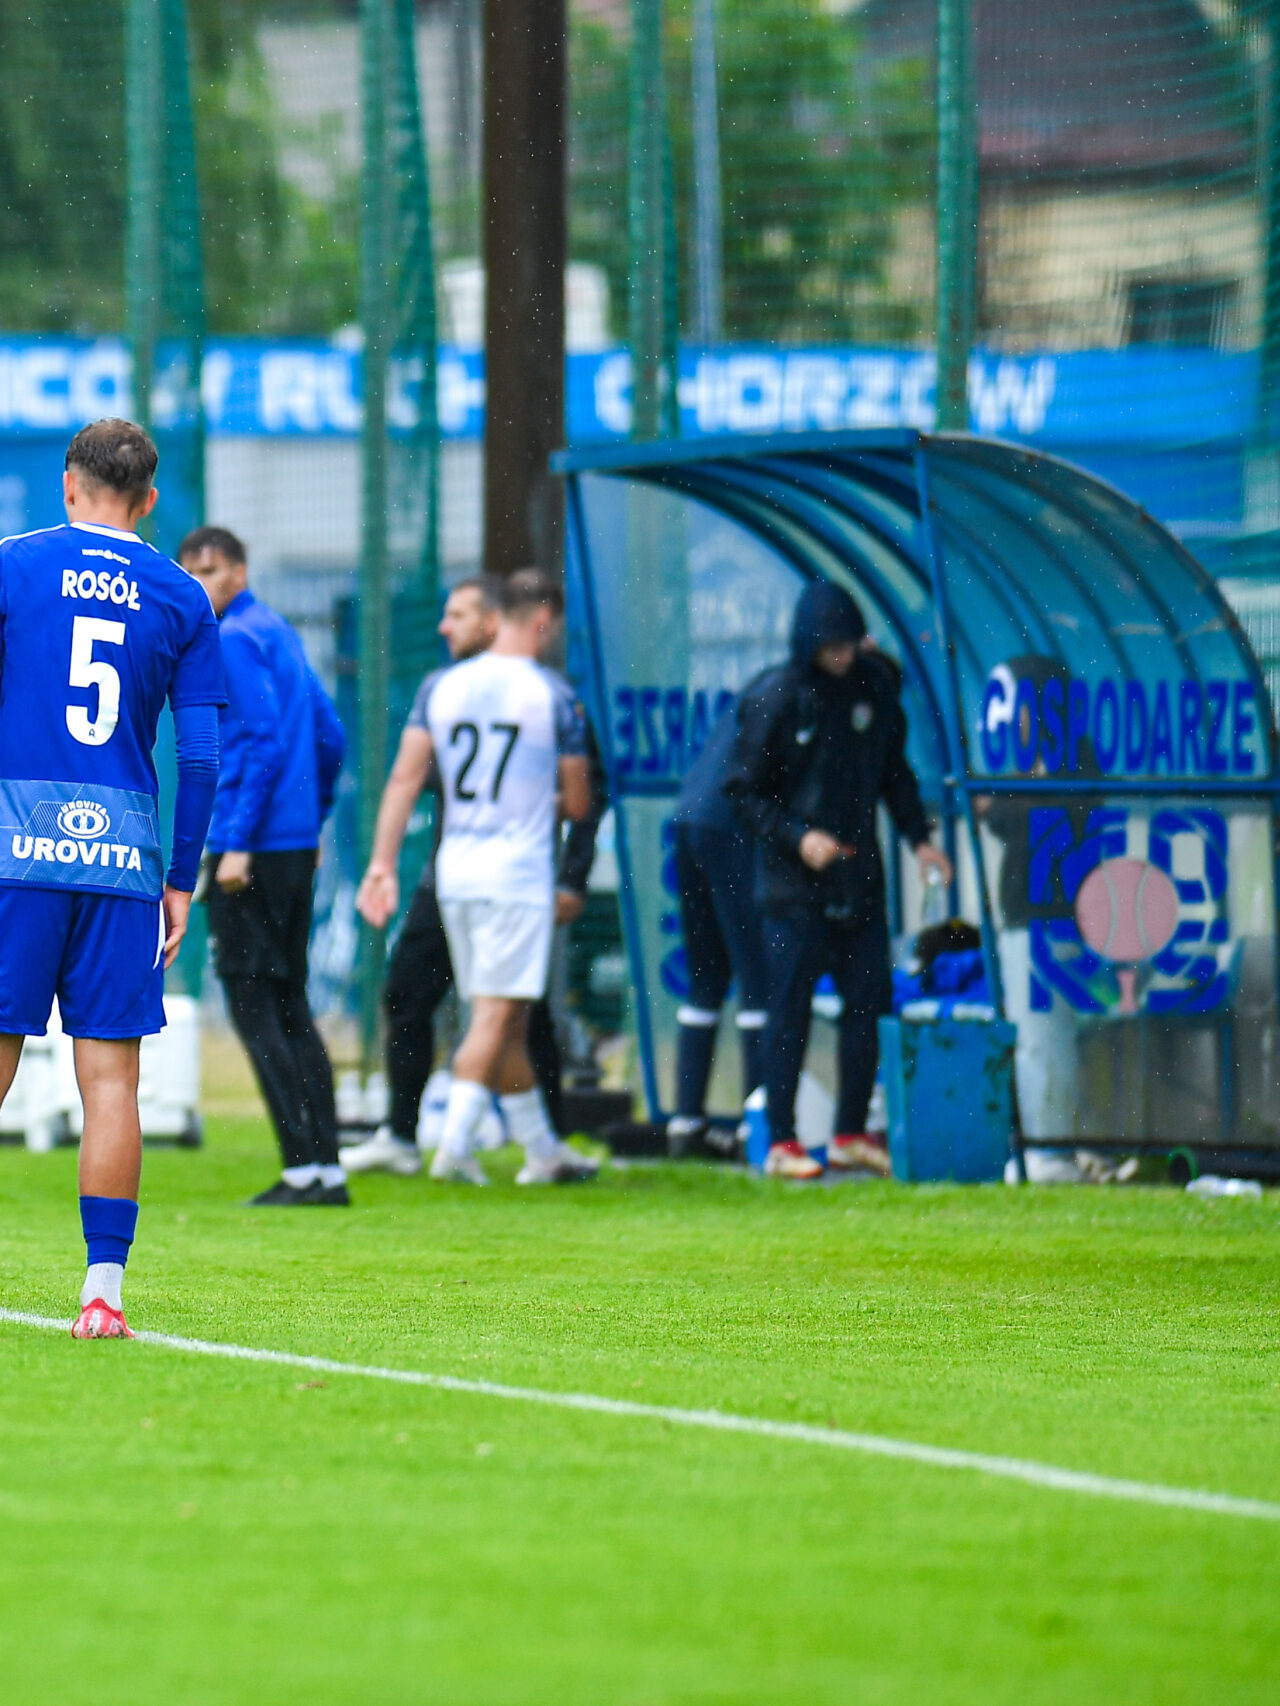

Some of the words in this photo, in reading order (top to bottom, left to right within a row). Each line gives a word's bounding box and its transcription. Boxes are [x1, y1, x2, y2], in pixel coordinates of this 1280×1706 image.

[61, 569, 141, 611] ROSÓŁ
[65, 615, 126, 746] 5
[451, 721, 522, 803] 27
[982, 678, 1255, 774] GOSPODARZE
[12, 834, 142, 872] UROVITA
